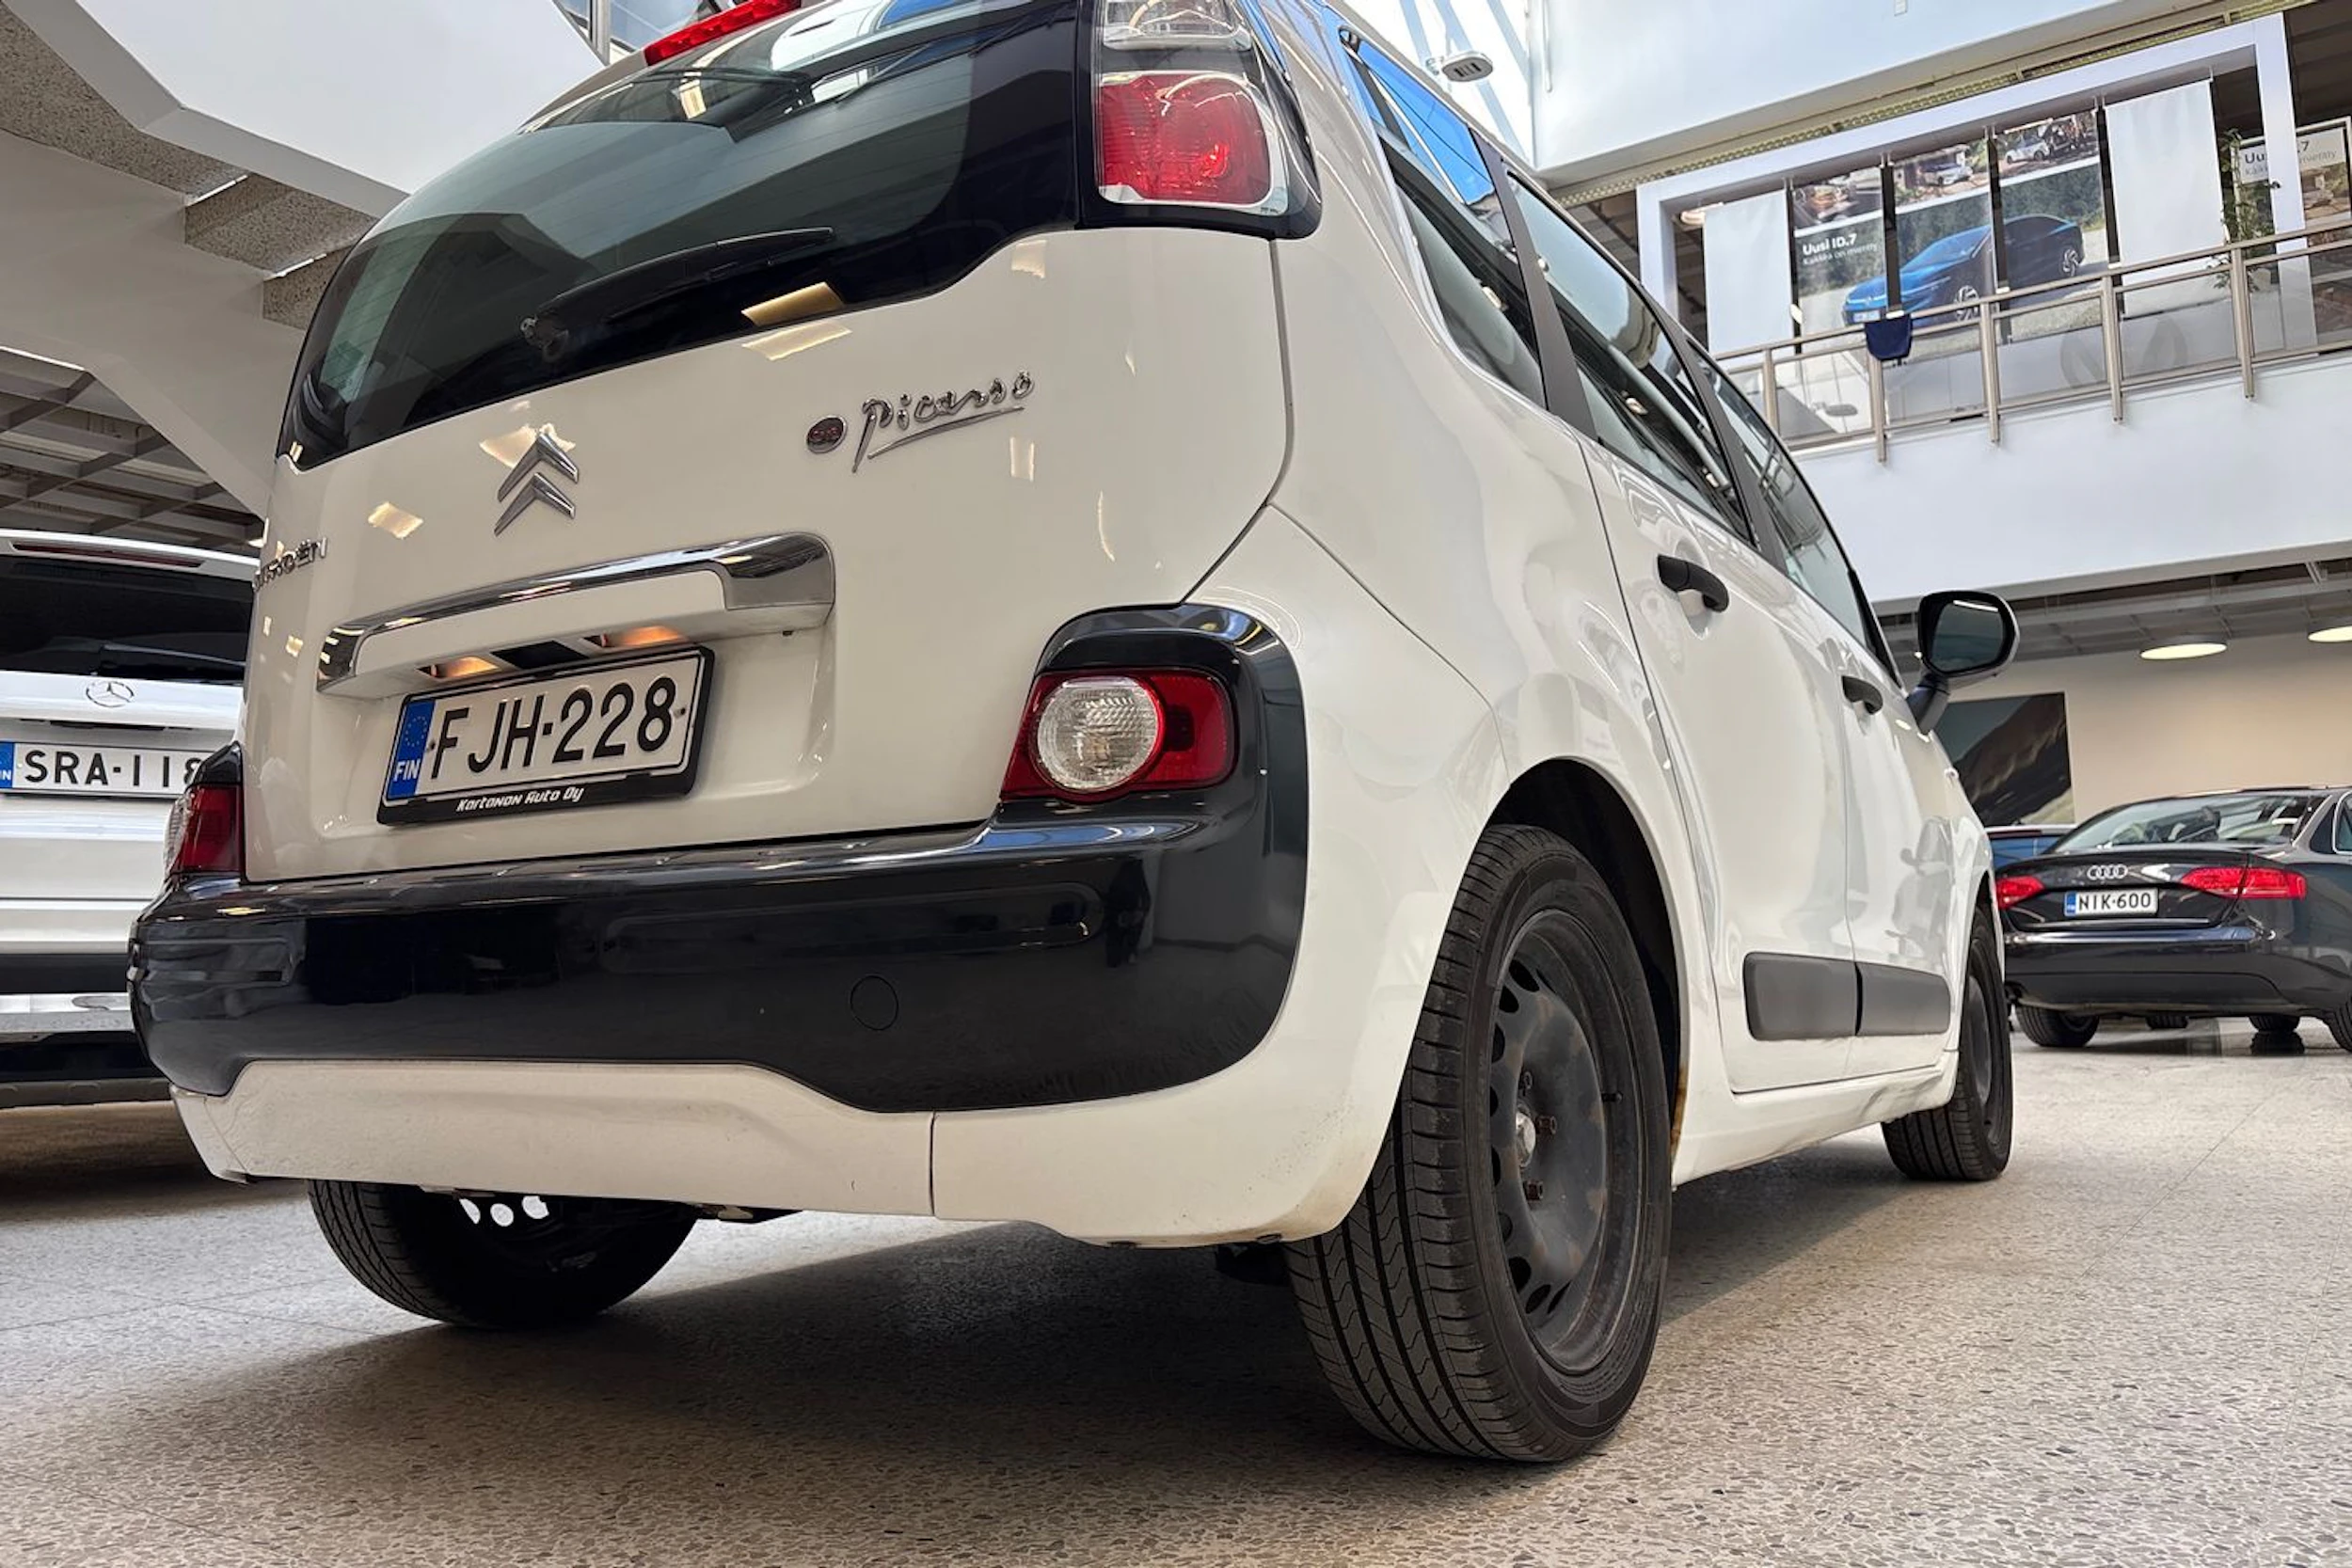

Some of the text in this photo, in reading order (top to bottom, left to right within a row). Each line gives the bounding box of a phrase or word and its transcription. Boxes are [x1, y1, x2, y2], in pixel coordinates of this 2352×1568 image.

[2245, 152, 2265, 164] Uu
[1803, 238, 1830, 256] Uusi
[1832, 233, 1857, 248] ID.7
[850, 371, 1035, 473] Picasso
[431, 676, 676, 780] FJH-228
[0, 769, 11, 781] IN
[392, 758, 421, 783] FIN
[525, 790, 561, 804] Auto
[563, 786, 584, 802] Oy
[2079, 893, 2151, 911] NIK-600
